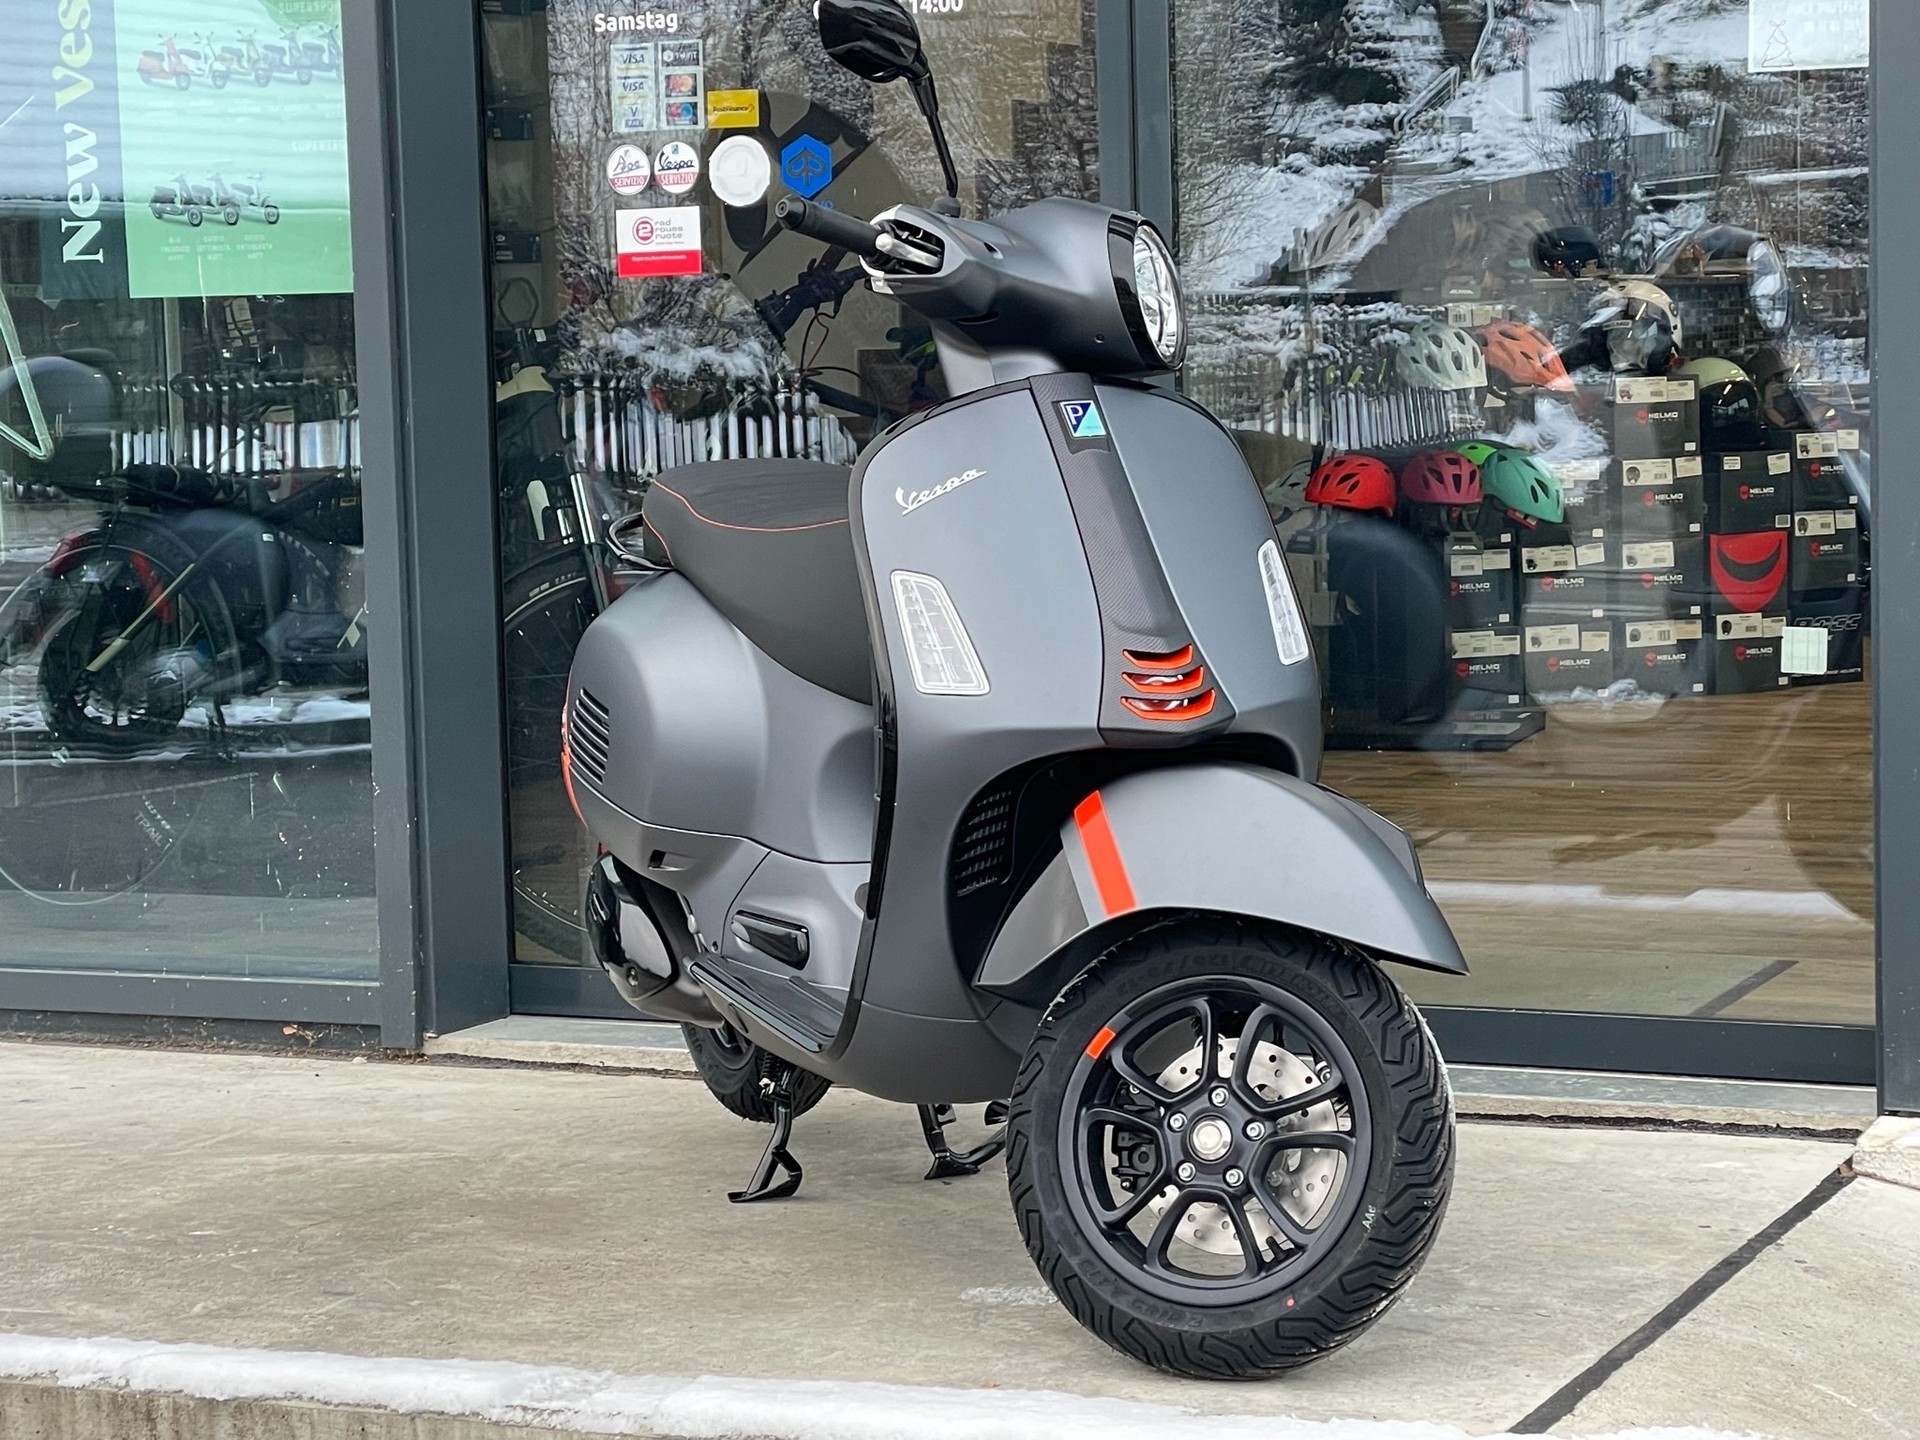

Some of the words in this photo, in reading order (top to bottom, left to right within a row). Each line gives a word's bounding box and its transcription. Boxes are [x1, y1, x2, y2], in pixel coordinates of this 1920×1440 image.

[911, 0, 964, 14] 14:00
[594, 11, 678, 33] Samstag
[621, 53, 645, 65] VISA
[622, 81, 645, 92] VISA
[657, 150, 696, 172] Vespa
[614, 177, 645, 188] SERVIZIO
[660, 173, 694, 185] SERVIZIO
[60, 121, 104, 264] New
[654, 218, 672, 227] rad
[654, 232, 683, 240] ruote
[1065, 404, 1084, 426] P
[1648, 411, 1678, 419] HELMO
[895, 468, 988, 517] Vespa
[1553, 577, 1585, 585] HELMO
[1653, 574, 1684, 582] HELMO
[1459, 582, 1491, 590] HELMO
[1746, 647, 1773, 655] HELMO
[1469, 663, 1500, 671] HELMO
[1559, 658, 1591, 666] HELMO
